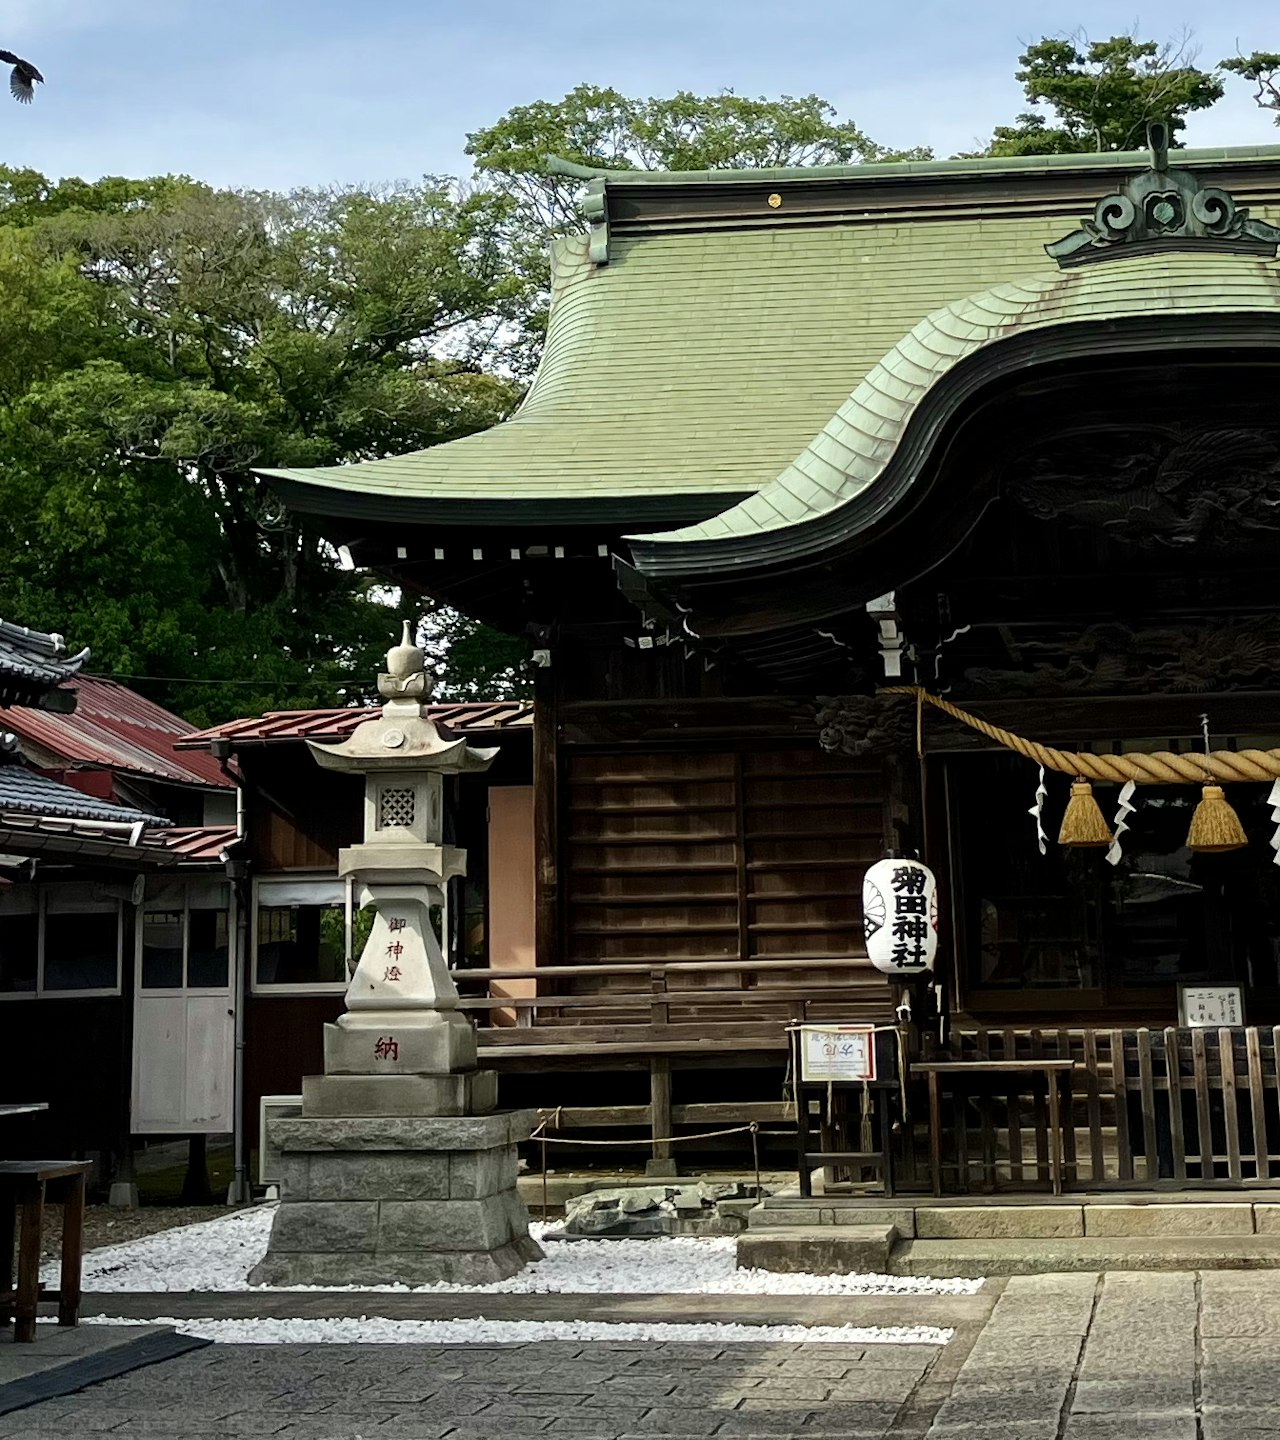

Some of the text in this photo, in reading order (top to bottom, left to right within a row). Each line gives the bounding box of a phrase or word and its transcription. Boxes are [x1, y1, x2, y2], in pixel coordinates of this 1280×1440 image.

[383, 916, 407, 982] 御神燈
[890, 866, 928, 968] 菊田神社
[374, 1036, 399, 1061] 納
